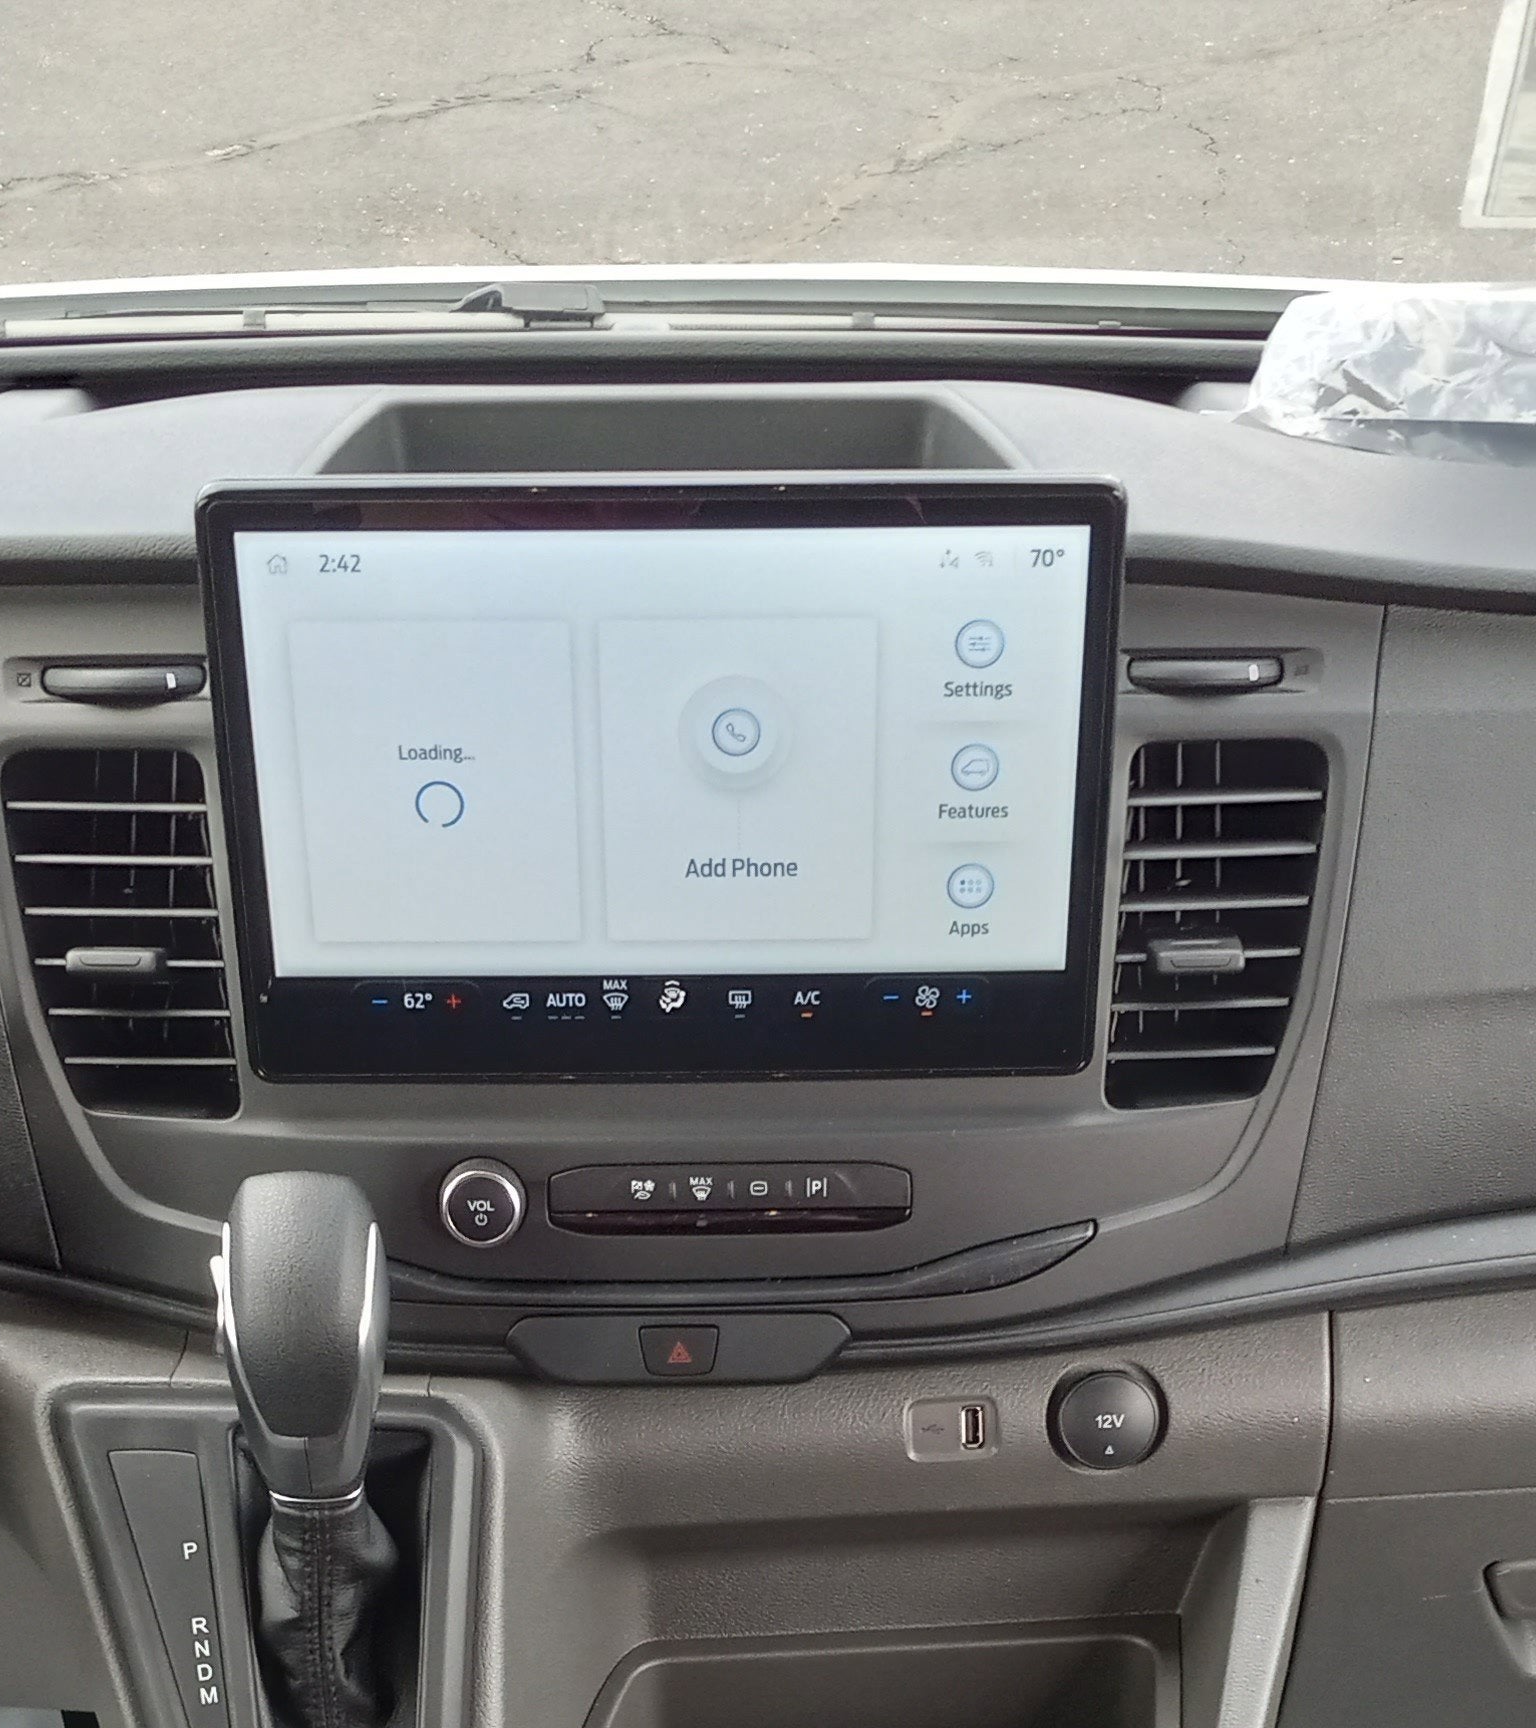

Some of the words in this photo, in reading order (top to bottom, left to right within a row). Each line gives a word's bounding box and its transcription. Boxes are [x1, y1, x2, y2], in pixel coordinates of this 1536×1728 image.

[318, 554, 362, 573] 2:42
[1030, 548, 1066, 568] 70°
[943, 681, 1013, 699] Settings
[938, 803, 1009, 819] Features
[684, 857, 727, 878] Add
[730, 857, 799, 878] Phone
[949, 920, 989, 937] Apps
[602, 979, 628, 991] MAX
[403, 992, 434, 1009] 62°
[546, 992, 586, 1009] AUTO
[794, 990, 821, 1007] A/C
[689, 1176, 713, 1186] MAX
[467, 1199, 495, 1212] VOL
[1095, 1413, 1125, 1430] 12V
[182, 1541, 198, 1560] P
[191, 1616, 209, 1635] R
[194, 1640, 211, 1658] N
[196, 1664, 213, 1682] D
[199, 1686, 219, 1705] M
